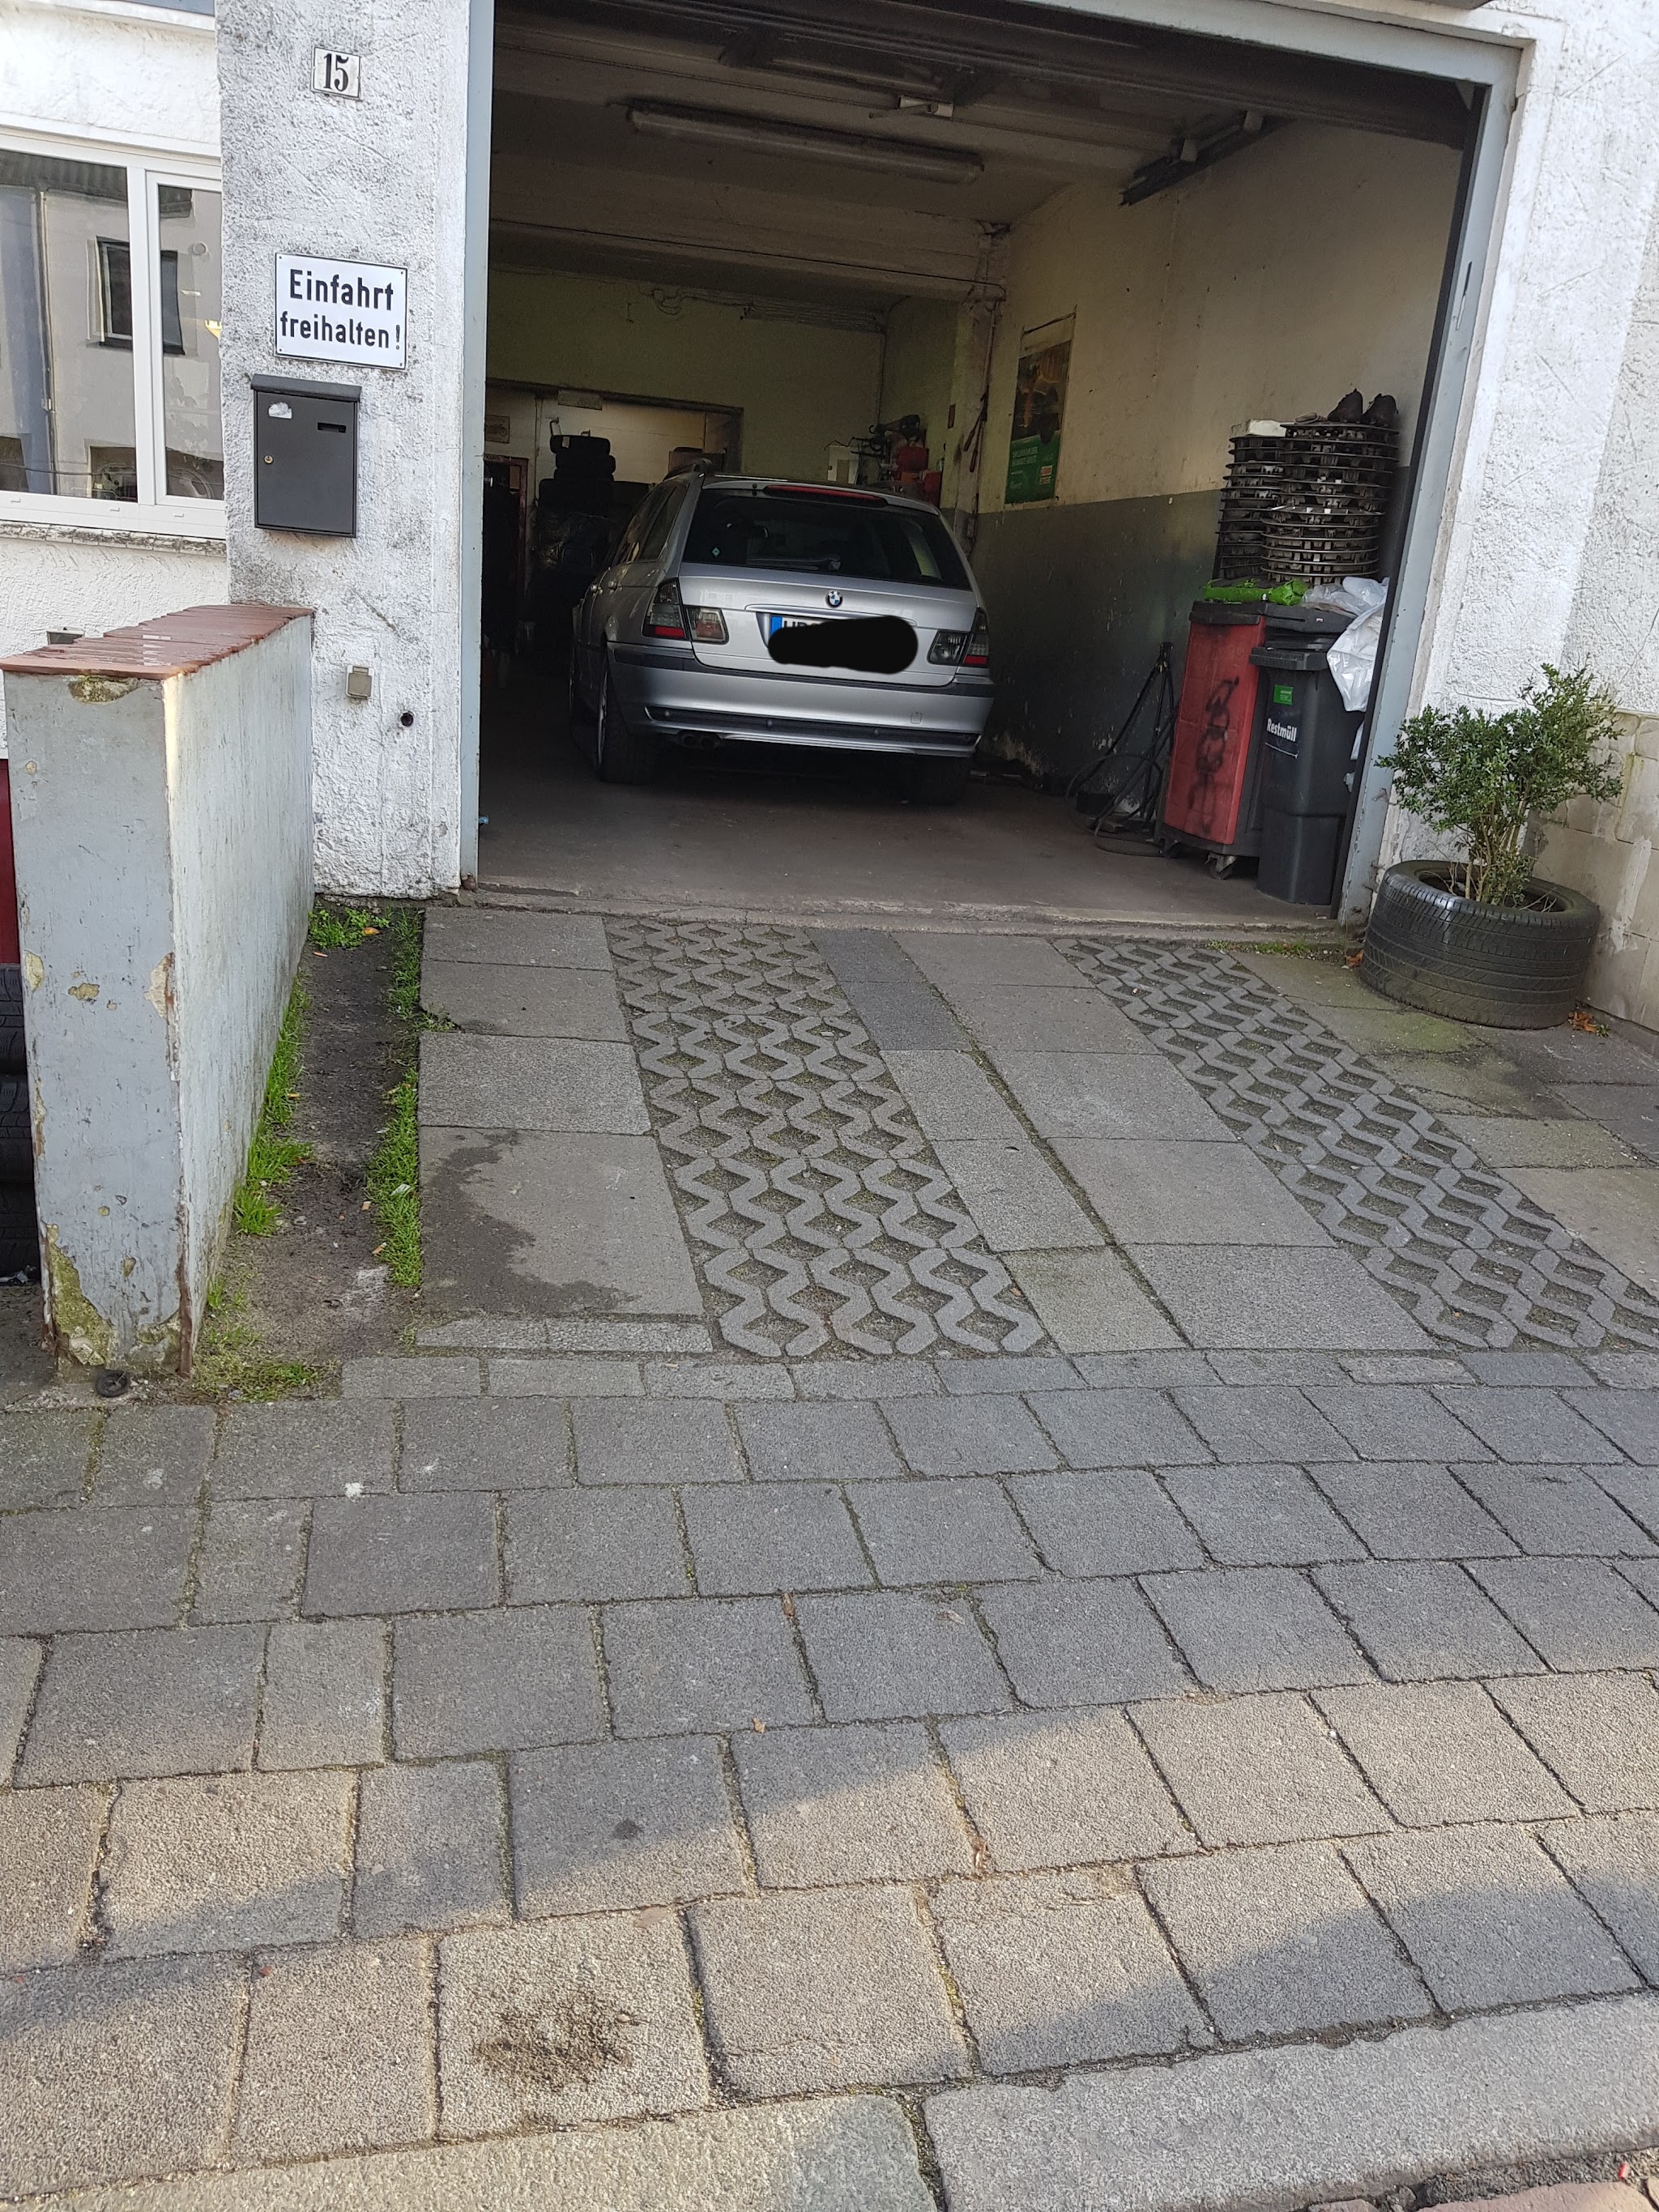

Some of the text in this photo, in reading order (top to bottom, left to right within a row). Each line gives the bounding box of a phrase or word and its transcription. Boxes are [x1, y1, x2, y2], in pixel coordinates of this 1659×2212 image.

[323, 53, 349, 92] 15
[290, 268, 394, 311] Einfahrt
[1266, 718, 1297, 742] Restmüll
